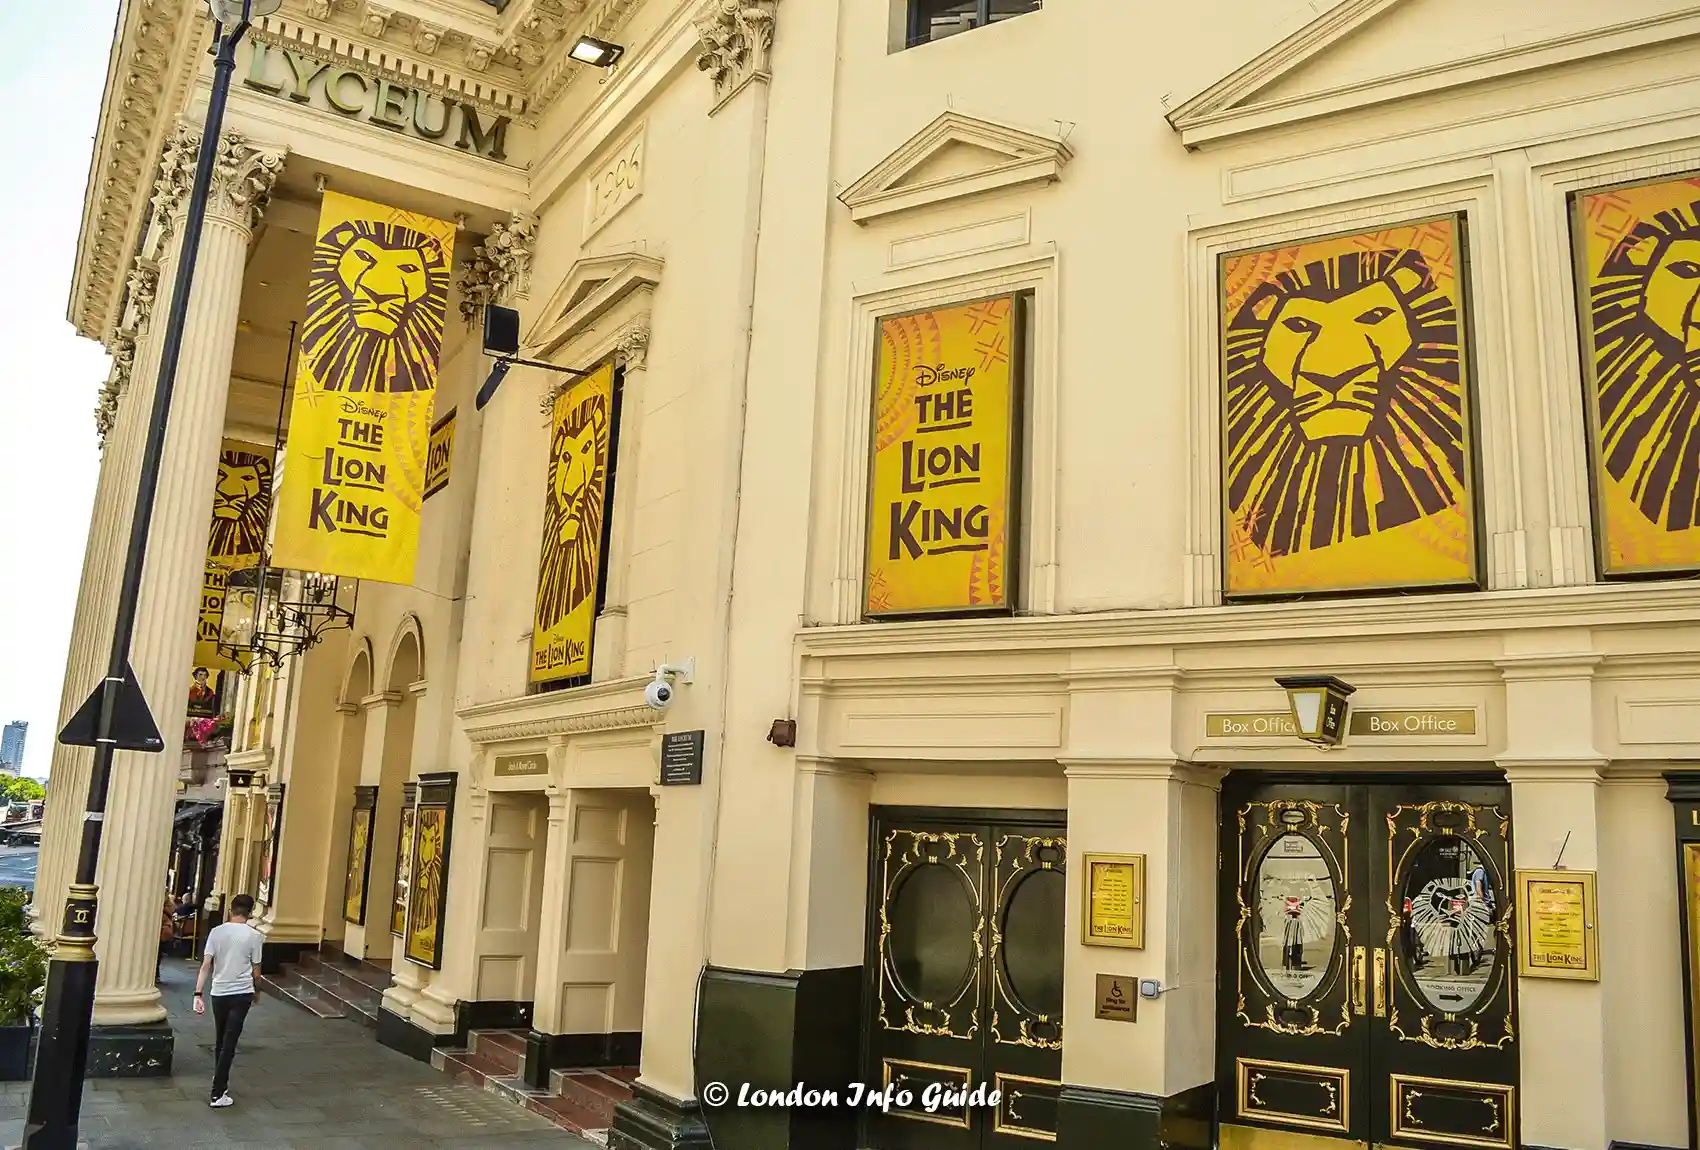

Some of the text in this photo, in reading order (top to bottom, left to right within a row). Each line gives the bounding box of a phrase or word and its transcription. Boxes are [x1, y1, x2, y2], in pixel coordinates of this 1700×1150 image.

[243, 39, 512, 160] LYCEUM
[914, 388, 973, 424] THE
[338, 418, 384, 446] THE
[1223, 716, 1297, 734] Box Offic
[1370, 714, 1457, 732] Box Office
